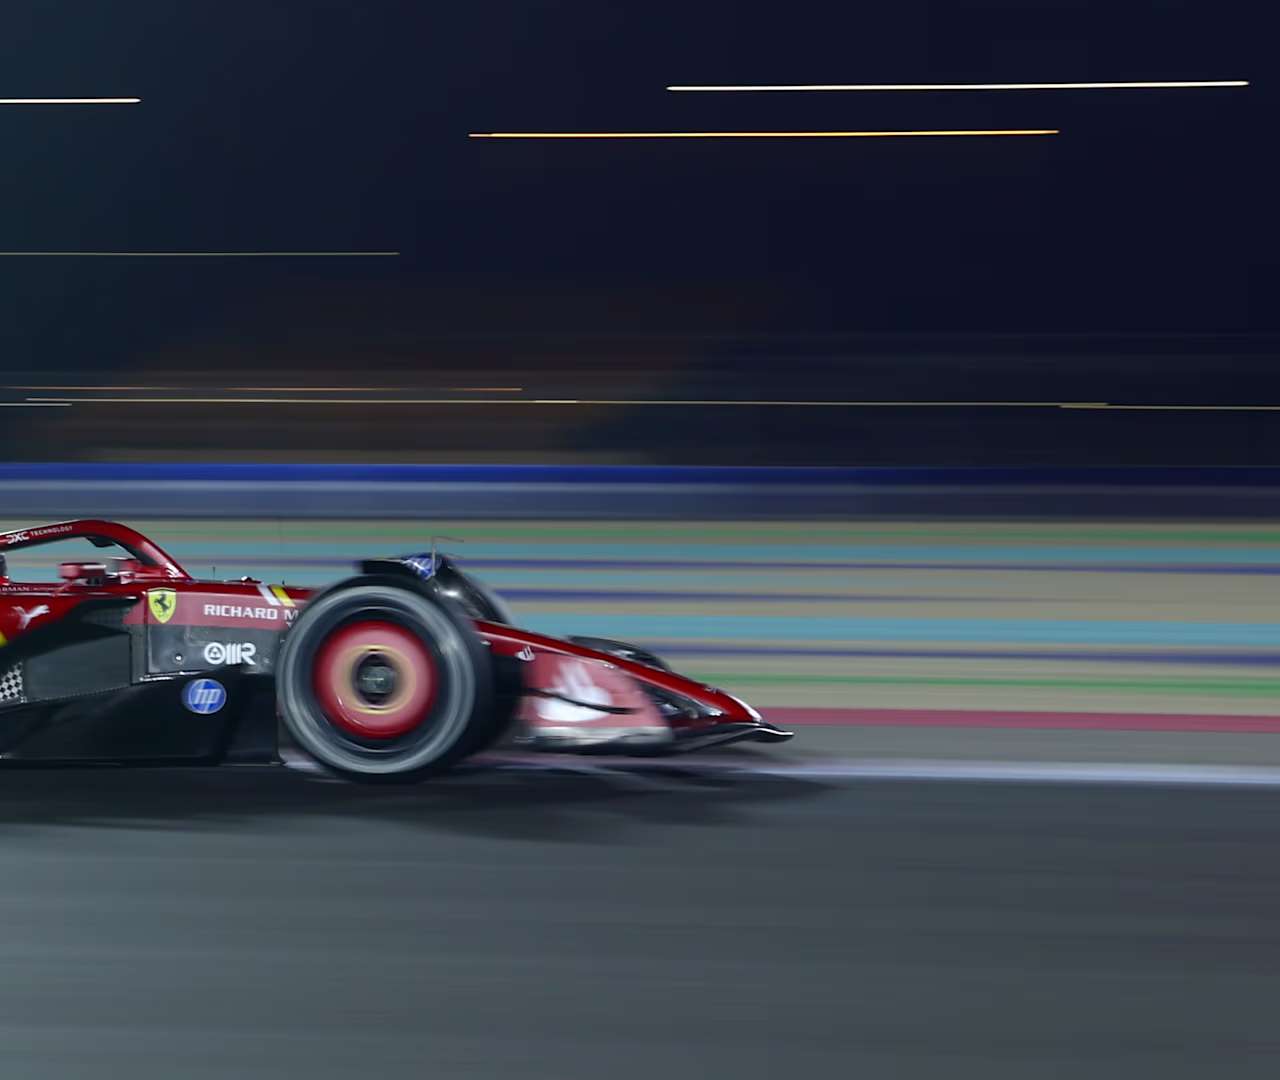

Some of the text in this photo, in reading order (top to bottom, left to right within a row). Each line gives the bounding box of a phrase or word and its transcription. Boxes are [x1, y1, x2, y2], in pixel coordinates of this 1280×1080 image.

[30, 525, 73, 537] TECHNOLOGY
[204, 604, 278, 620] RICHARD
[190, 679, 226, 714] hp
